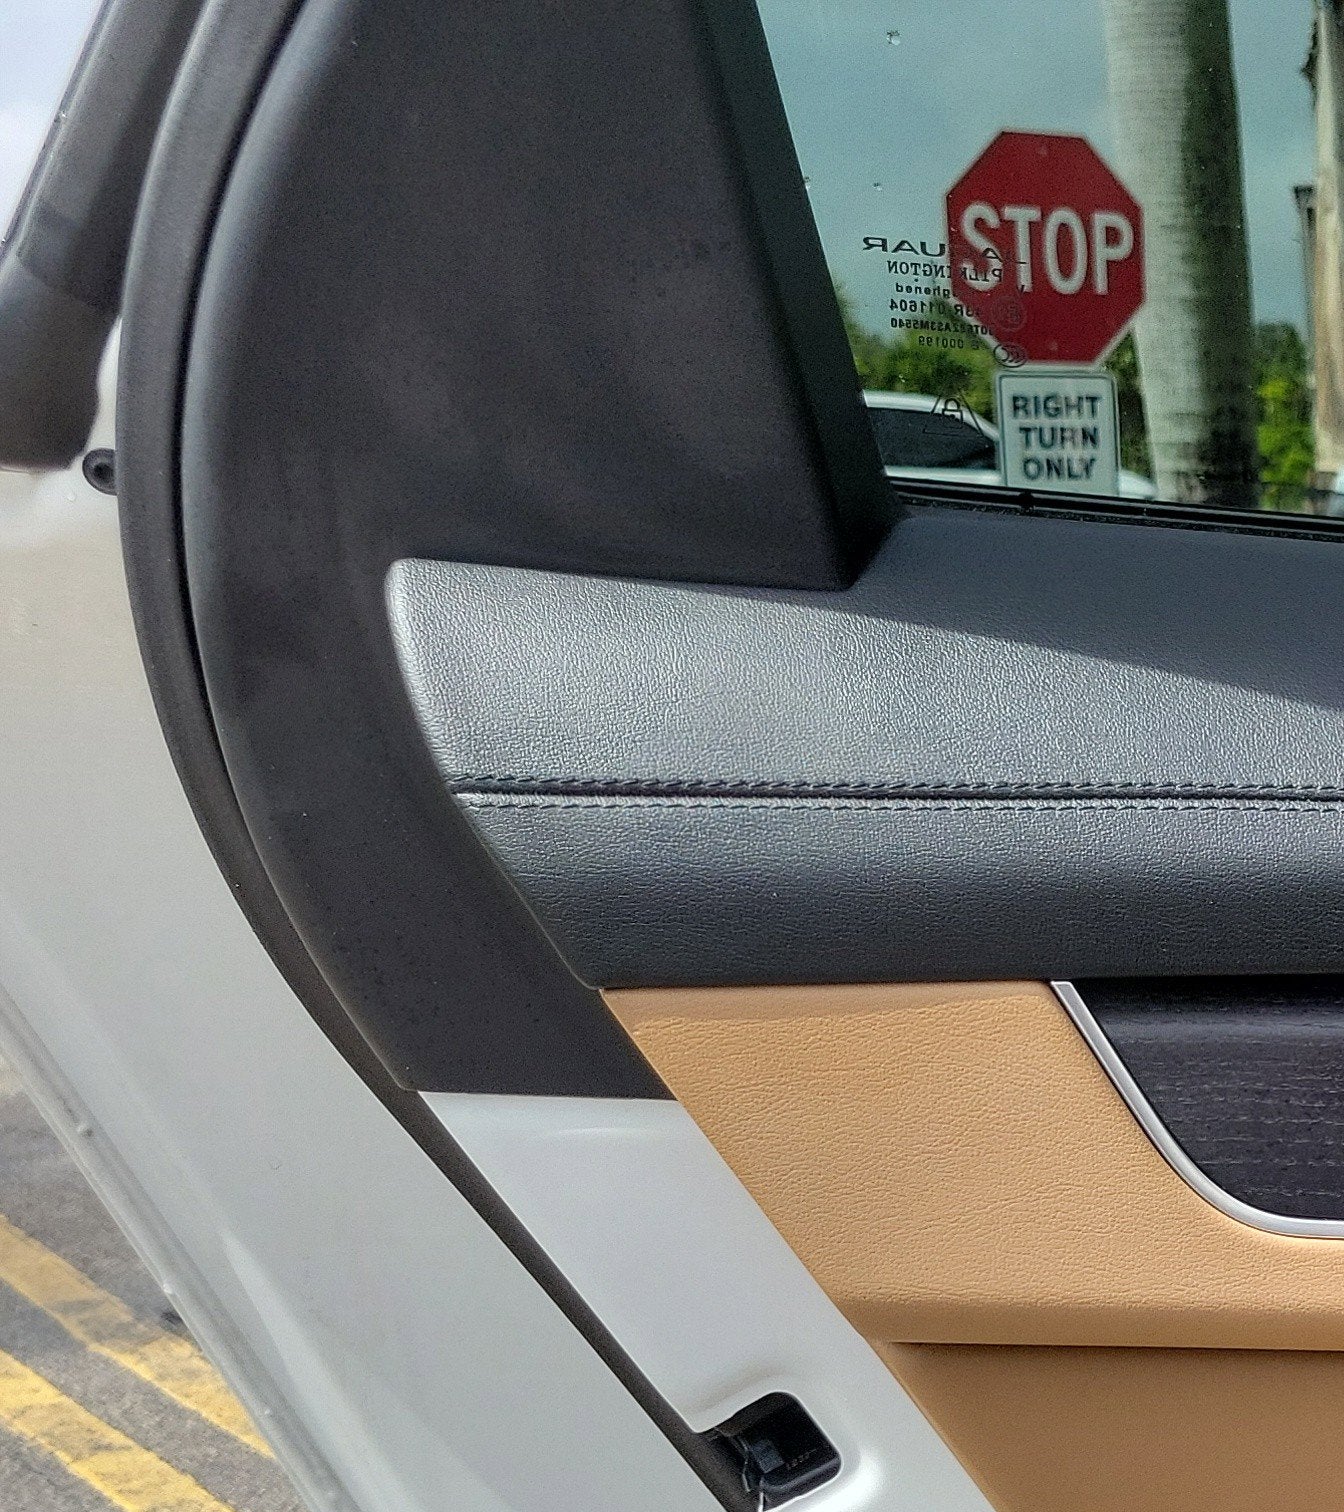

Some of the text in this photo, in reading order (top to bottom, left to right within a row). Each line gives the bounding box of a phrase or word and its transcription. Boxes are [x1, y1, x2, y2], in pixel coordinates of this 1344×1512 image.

[961, 201, 1134, 295] STOP
[1012, 394, 1101, 420] RIGHT
[1019, 426, 1099, 450] TURN
[1022, 455, 1096, 481] ONLY
